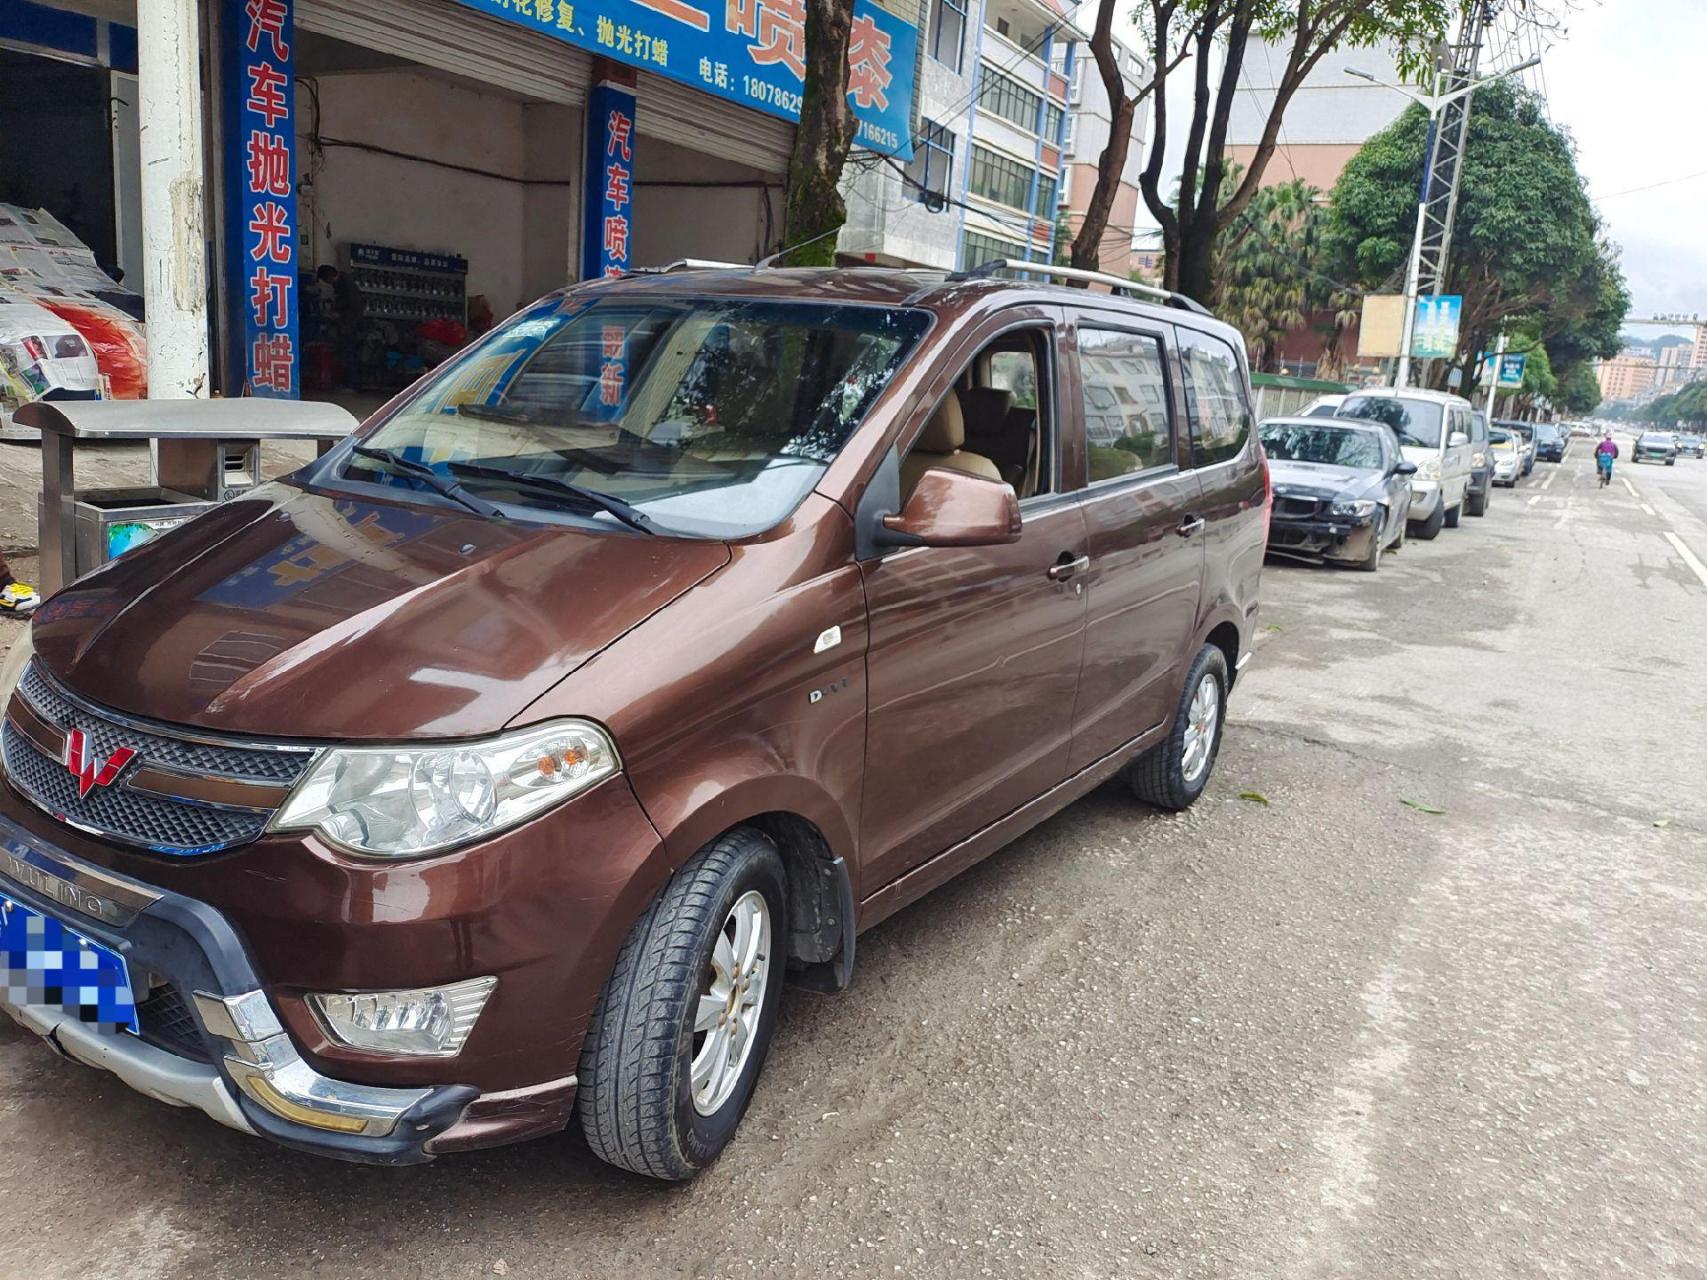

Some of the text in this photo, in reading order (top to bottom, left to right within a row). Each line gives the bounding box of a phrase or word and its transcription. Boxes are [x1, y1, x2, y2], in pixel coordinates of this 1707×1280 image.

[245, 0, 294, 392] 汽车抛光打蜡
[8, 855, 104, 917] WULING
